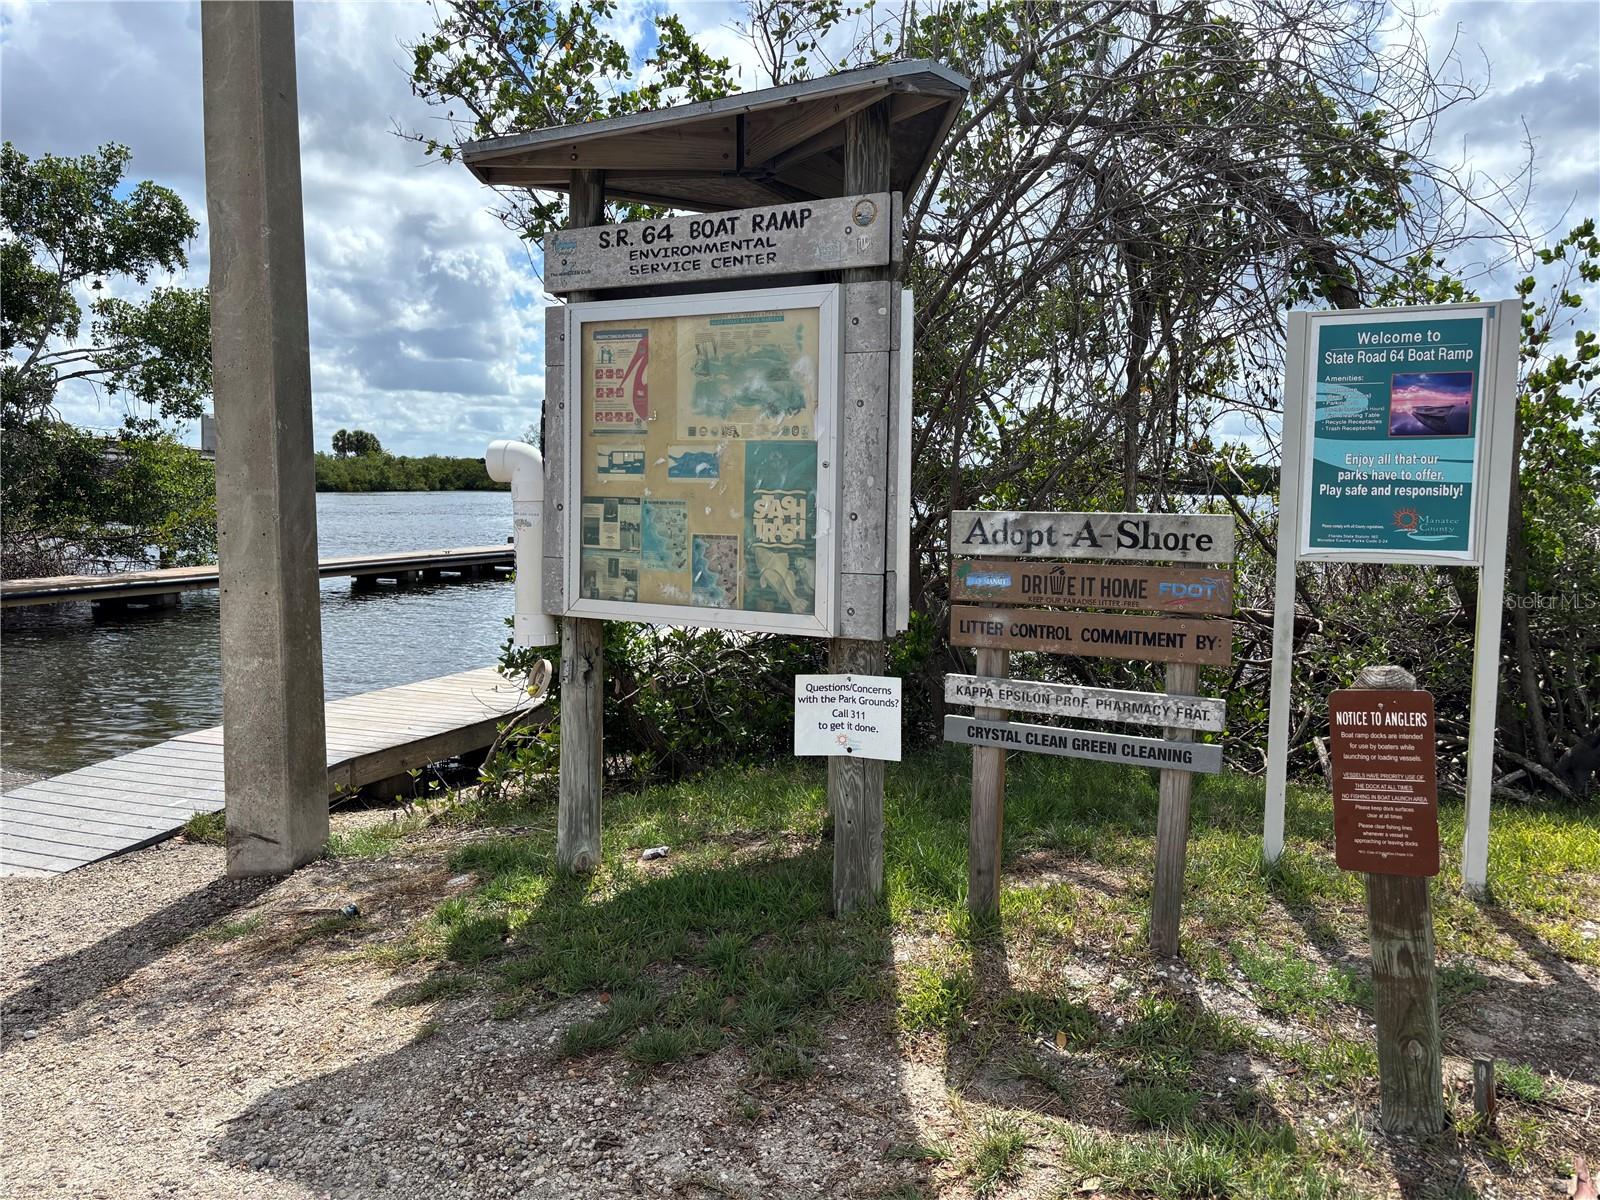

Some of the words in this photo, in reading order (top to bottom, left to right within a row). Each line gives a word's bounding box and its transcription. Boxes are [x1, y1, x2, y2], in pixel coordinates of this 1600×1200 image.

[599, 229, 634, 249] S.R.
[642, 224, 674, 245] 64
[690, 216, 741, 241] BOAT
[752, 208, 812, 234] RAMP
[629, 237, 777, 261] ENVIRONMENTAL
[629, 259, 701, 276] SERVICE
[711, 252, 777, 269] CENTER
[1358, 331, 1423, 345] Welcome
[1427, 330, 1441, 342] to
[1324, 352, 1354, 365] State
[1357, 351, 1387, 364] Road
[1389, 350, 1405, 362] 64
[1408, 349, 1435, 362] Boat
[1438, 347, 1473, 362] Ramp
[1325, 375, 1365, 383] Amenities:
[1345, 453, 1375, 468] Enjoy
[1377, 453, 1391, 465] all
[1395, 453, 1417, 465] that
[1420, 457, 1439, 465] our
[1338, 470, 1368, 482] parks
[1371, 470, 1397, 480] have
[1401, 470, 1412, 480] to
[1415, 470, 1444, 480] offer.
[1319, 484, 1342, 498] Play
[1345, 484, 1368, 496] safe
[1371, 485, 1391, 496] and
[1394, 484, 1464, 499] responsibly!
[962, 516, 1213, 554] Adopt-A-Shore
[1080, 577, 1096, 597] IT
[1101, 578, 1148, 599] HOME
[1159, 580, 1217, 599] FDOT
[959, 619, 1003, 637] LITTER
[1010, 623, 1073, 641] CONTROL
[1081, 628, 1187, 649] COMMITMENT
[1196, 635, 1222, 651] BY:
[805, 683, 892, 696] Questions/Concerns
[798, 695, 819, 704] with
[820, 695, 836, 704] the
[838, 694, 857, 705] Park
[858, 696, 899, 708] Grounds?
[956, 685, 994, 699] KAPPA
[998, 689, 1051, 705] EPSILON
[1055, 694, 1090, 709] PROF.
[1095, 699, 1170, 717] PHARMACY
[1176, 707, 1211, 722] FRAT.
[832, 708, 849, 718] Call
[850, 710, 865, 720] 311
[1336, 711, 1368, 726] NOTICE
[1370, 711, 1381, 726] TO
[1385, 712, 1428, 727] ANGLERS
[818, 721, 828, 730] to
[830, 722, 844, 732] get
[847, 722, 853, 731] it
[854, 725, 879, 734] done.
[1370, 731, 1387, 739] docks
[1399, 732, 1423, 740] intended
[967, 725, 1022, 744] CRYSTAL
[1025, 732, 1068, 749] CLEAN
[1071, 737, 1117, 755] GREEN
[1121, 743, 1193, 764] CLEANING
[1370, 743, 1377, 751] by
[1343, 753, 1370, 761] launching
